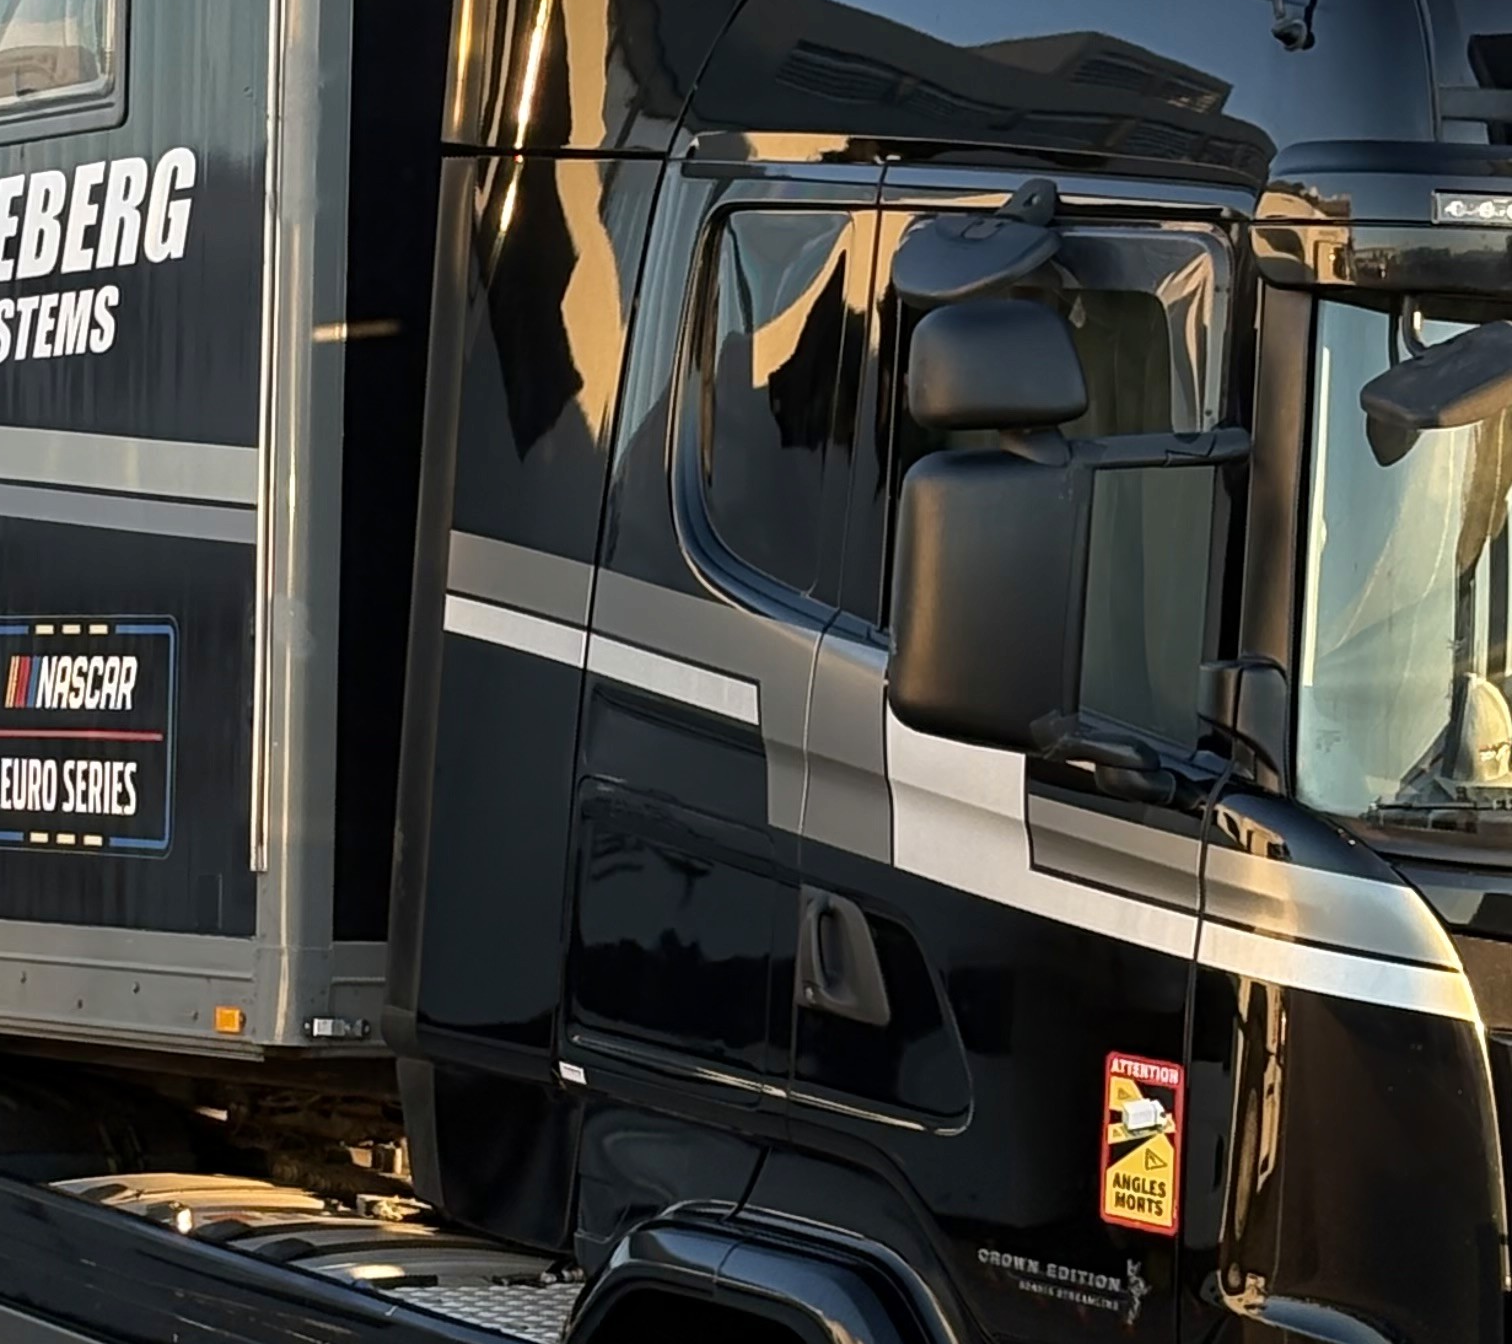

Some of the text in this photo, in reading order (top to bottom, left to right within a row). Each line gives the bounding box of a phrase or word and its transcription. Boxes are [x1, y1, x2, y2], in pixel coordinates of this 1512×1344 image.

[35, 656, 138, 710] NASCAR
[0, 758, 137, 815] EURO SERIES
[1110, 1058, 1179, 1084] ATTENTION
[1112, 1172, 1167, 1197] ANGLES
[1114, 1192, 1164, 1216] MORTS
[977, 1248, 1121, 1292] CROWN EDITION
